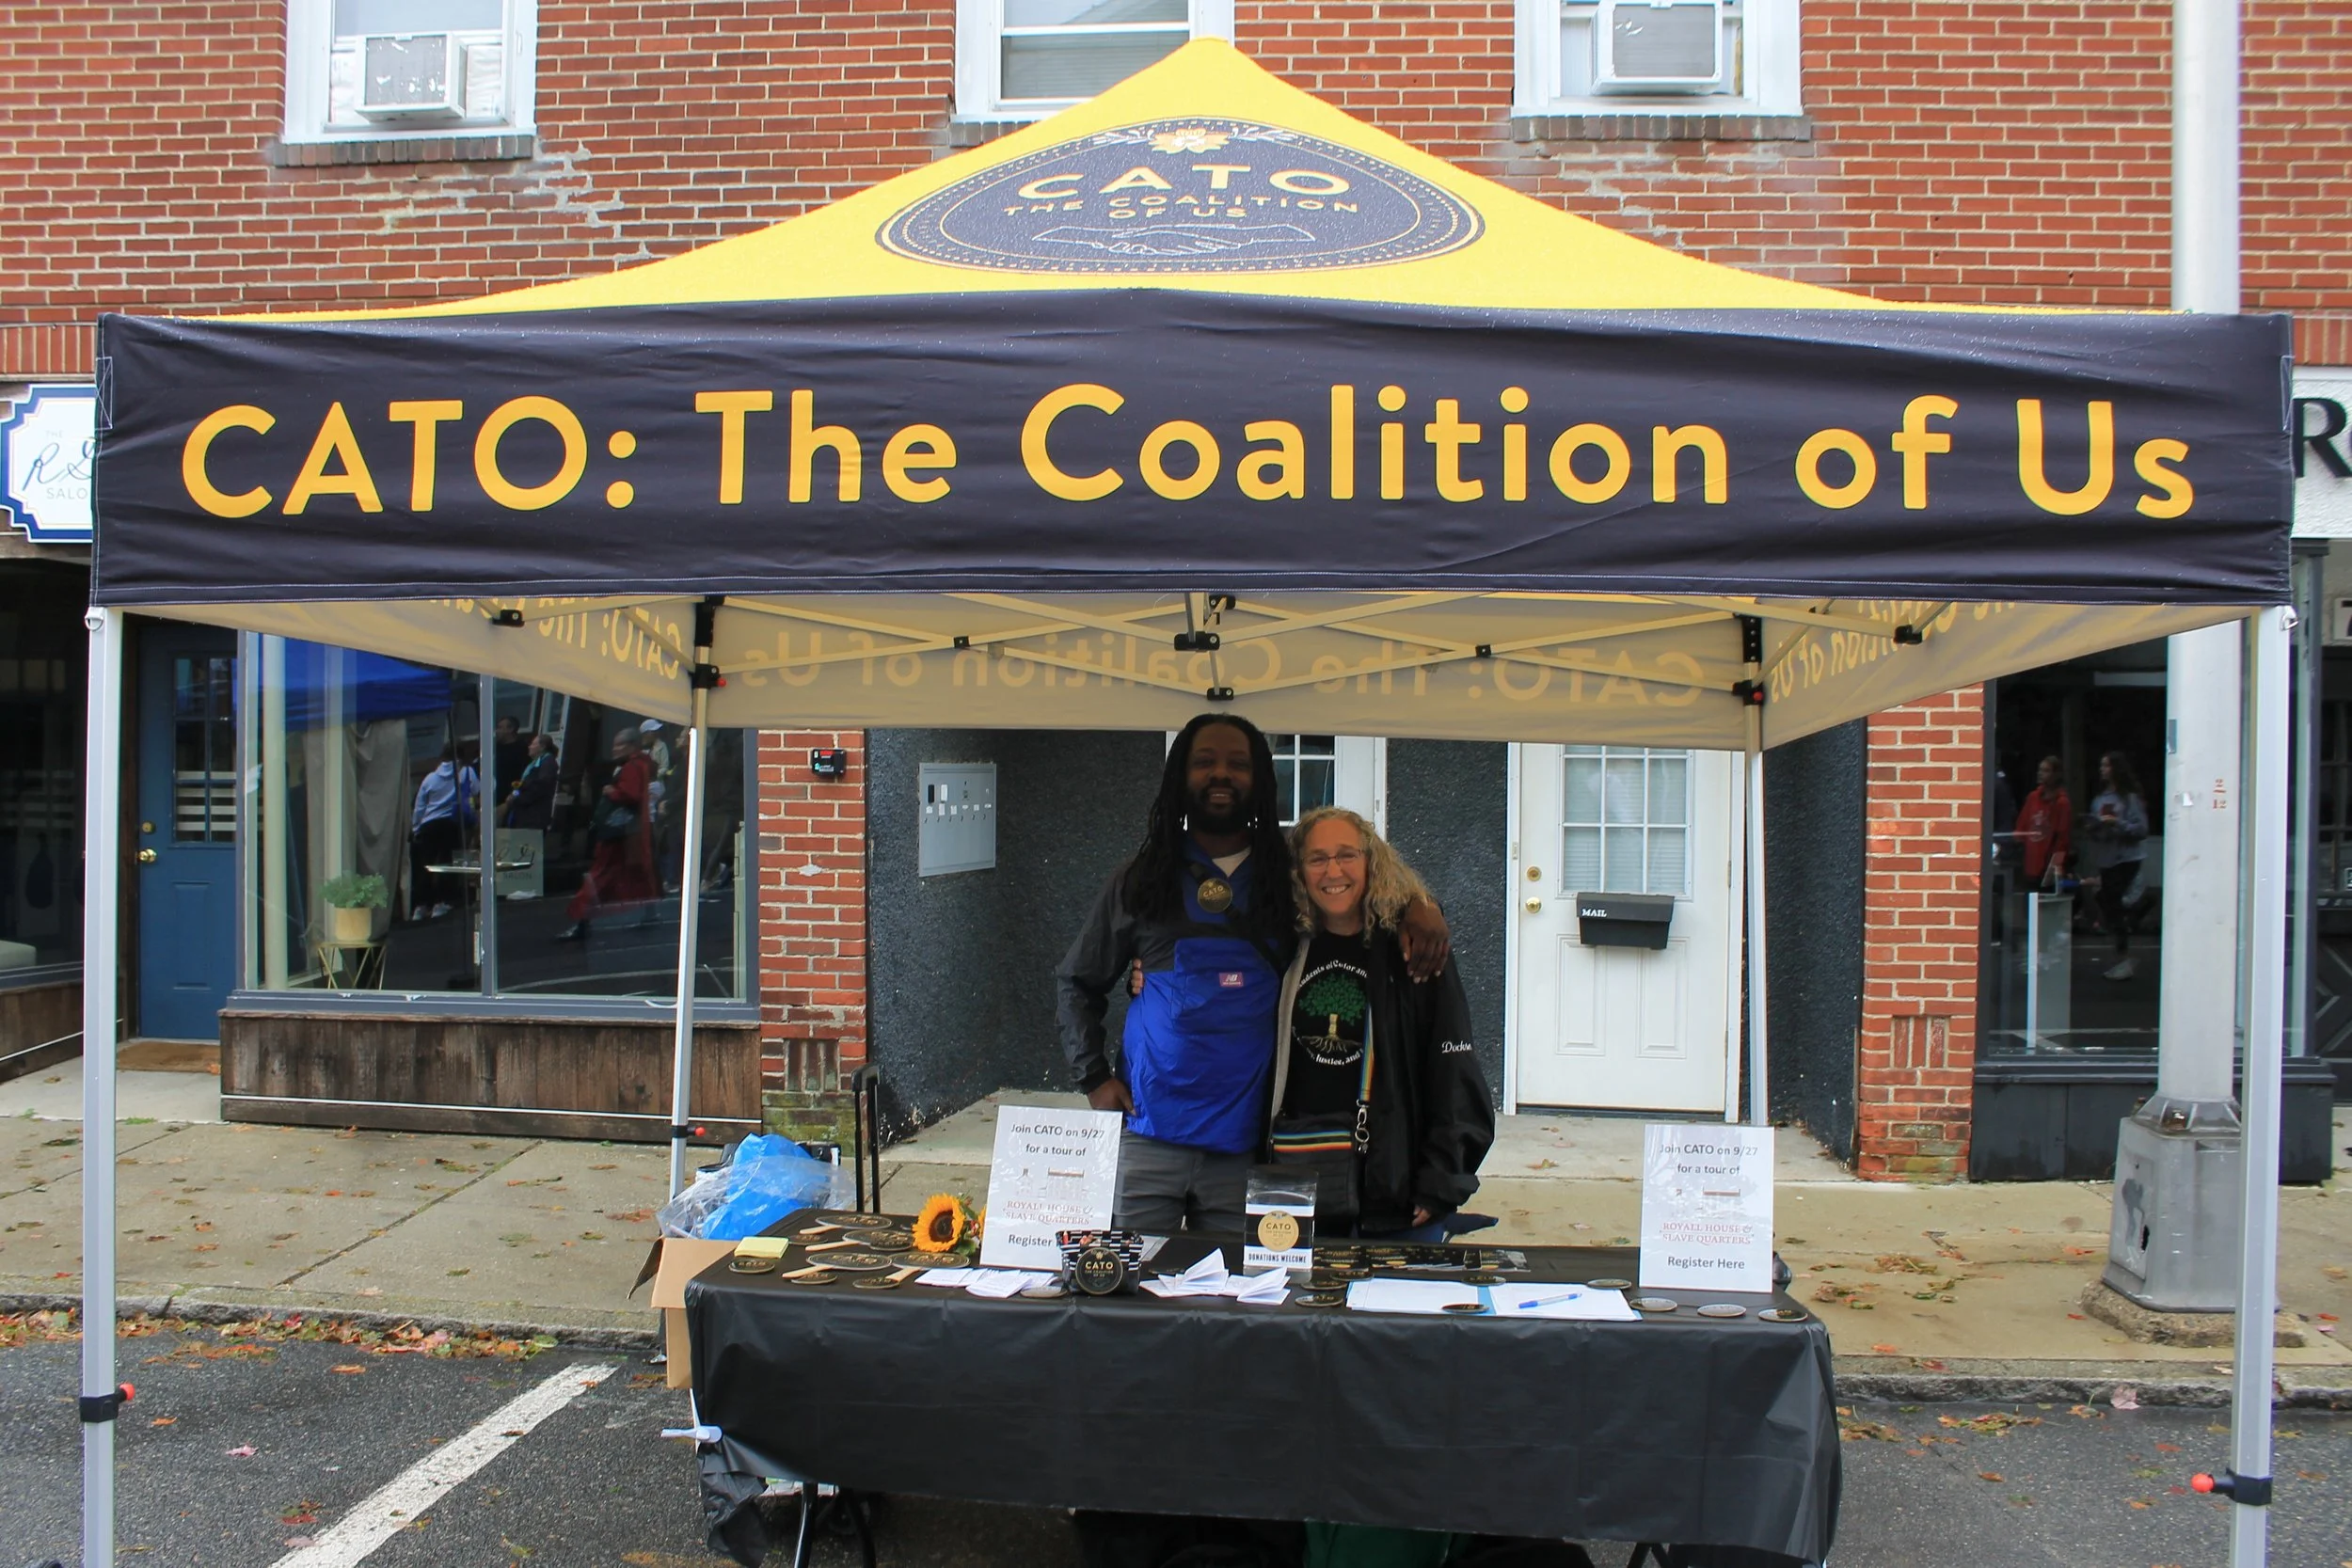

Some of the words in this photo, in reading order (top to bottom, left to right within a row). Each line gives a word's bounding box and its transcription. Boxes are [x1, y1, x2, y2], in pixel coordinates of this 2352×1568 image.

[1019, 164, 1350, 199] CATO
[1003, 200, 1085, 217] THE
[1108, 194, 1359, 214] COALITION
[1108, 207, 1167, 219] OF
[1191, 206, 1248, 218] US
[183, 395, 634, 518] CATO:
[694, 388, 957, 504] The
[1020, 383, 1728, 505] Coalition
[1795, 394, 1959, 511] of
[2016, 398, 2195, 519] Us
[46, 487, 88, 500] SALO
[1203, 884, 1225, 897] CATO
[1581, 908, 1607, 918] MAIL
[1011, 1124, 1031, 1134] Join
[1034, 1124, 1063, 1136] CATO
[1065, 1129, 1079, 1137] on
[1081, 1128, 1105, 1140] 9/27
[1025, 1143, 1041, 1154] for
[1052, 1146, 1073, 1156] tour
[1075, 1148, 1087, 1157] of
[1660, 1144, 1681, 1154] Join
[1683, 1144, 1715, 1155] CATO
[1717, 1147, 1731, 1155] on
[1733, 1147, 1758, 1157] 9/27
[1677, 1163, 1692, 1173] for
[1704, 1164, 1726, 1174] tour
[1729, 1165, 1740, 1175] of
[1047, 1203, 1081, 1213] HOUSE
[1005, 1211, 1036, 1221] SLAVE
[1038, 1212, 1089, 1225] QUARTERS
[1265, 1222, 1292, 1230] CATO
[1662, 1222, 1703, 1231] ROYALL
[1705, 1223, 1740, 1233] HOUSE
[1009, 1233, 1053, 1247] Register
[1662, 1233, 1694, 1243] SLAVE
[1696, 1233, 1752, 1245] QUARTERS
[1248, 1253, 1279, 1262] DONATIONS
[1280, 1255, 1307, 1263] WELCOME
[1667, 1256, 1714, 1269] Register
[1717, 1258, 1745, 1269] Here
[1085, 1260, 1114, 1270] CATO
